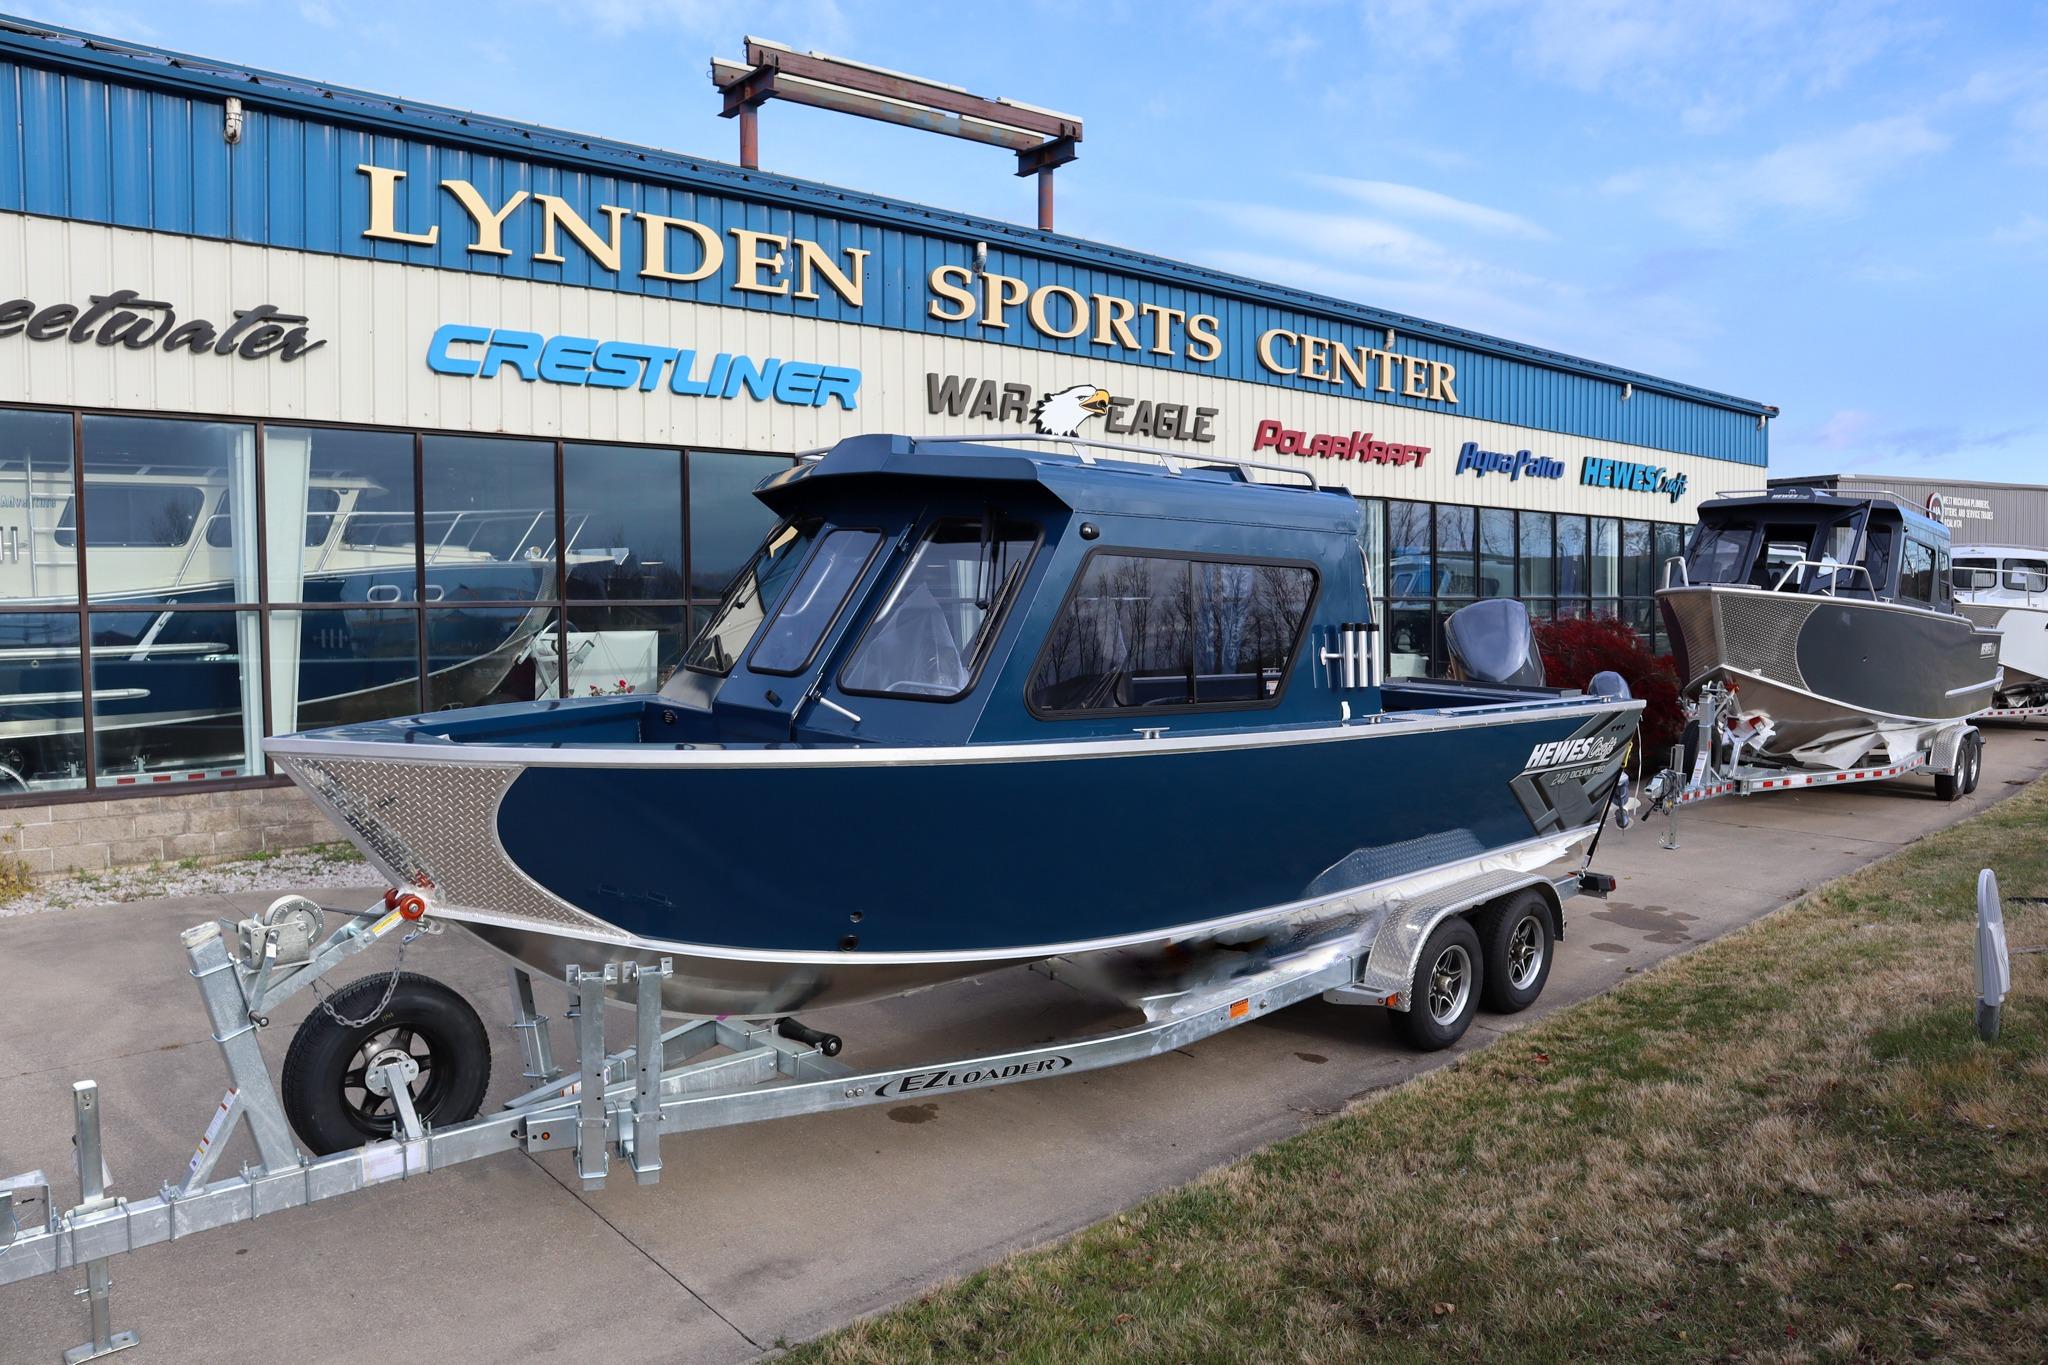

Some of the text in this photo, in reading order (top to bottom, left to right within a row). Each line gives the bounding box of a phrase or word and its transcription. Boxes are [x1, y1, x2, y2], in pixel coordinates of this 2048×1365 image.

[357, 164, 1459, 403] LYNDEN SPORTS CENTER
[426, 323, 862, 411] CRESTLINER
[927, 372, 1219, 442] WAR EAGLE
[1456, 441, 1565, 481] AquaPatio
[1550, 772, 1570, 787] 240
[1569, 767, 1592, 779] OCEAN
